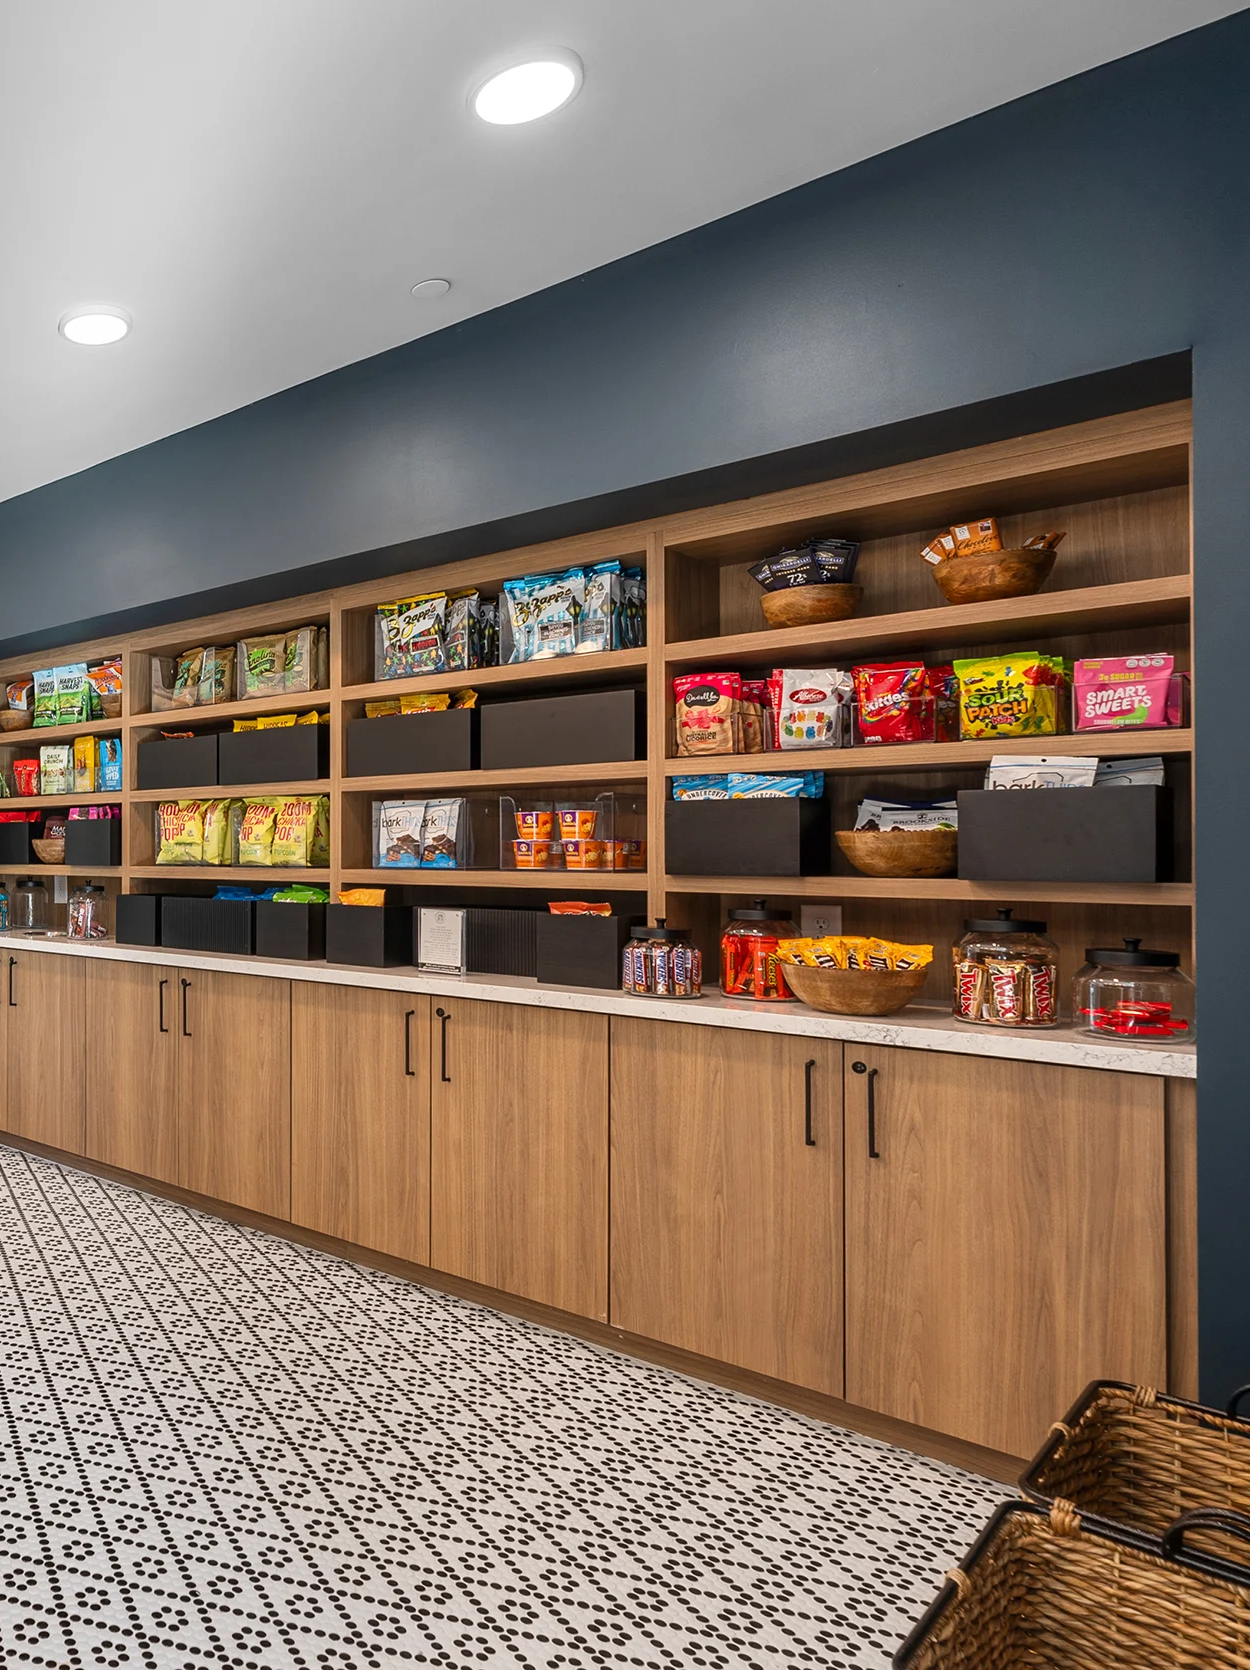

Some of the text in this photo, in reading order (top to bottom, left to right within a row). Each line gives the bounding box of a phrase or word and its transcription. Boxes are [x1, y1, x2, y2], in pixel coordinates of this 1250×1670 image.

[957, 533, 999, 551] Chocolove
[59, 676, 84, 684] HARVEST
[968, 688, 1025, 707] SOUR
[1086, 685, 1147, 705] SMART
[966, 700, 1028, 722] PATCH
[1085, 696, 1152, 718] SWEETS
[892, 816, 951, 825] BROOKSIDE
[635, 949, 645, 985] SNICKERS
[675, 948, 686, 985] SATISFIES
[768, 951, 780, 987] Reese's
